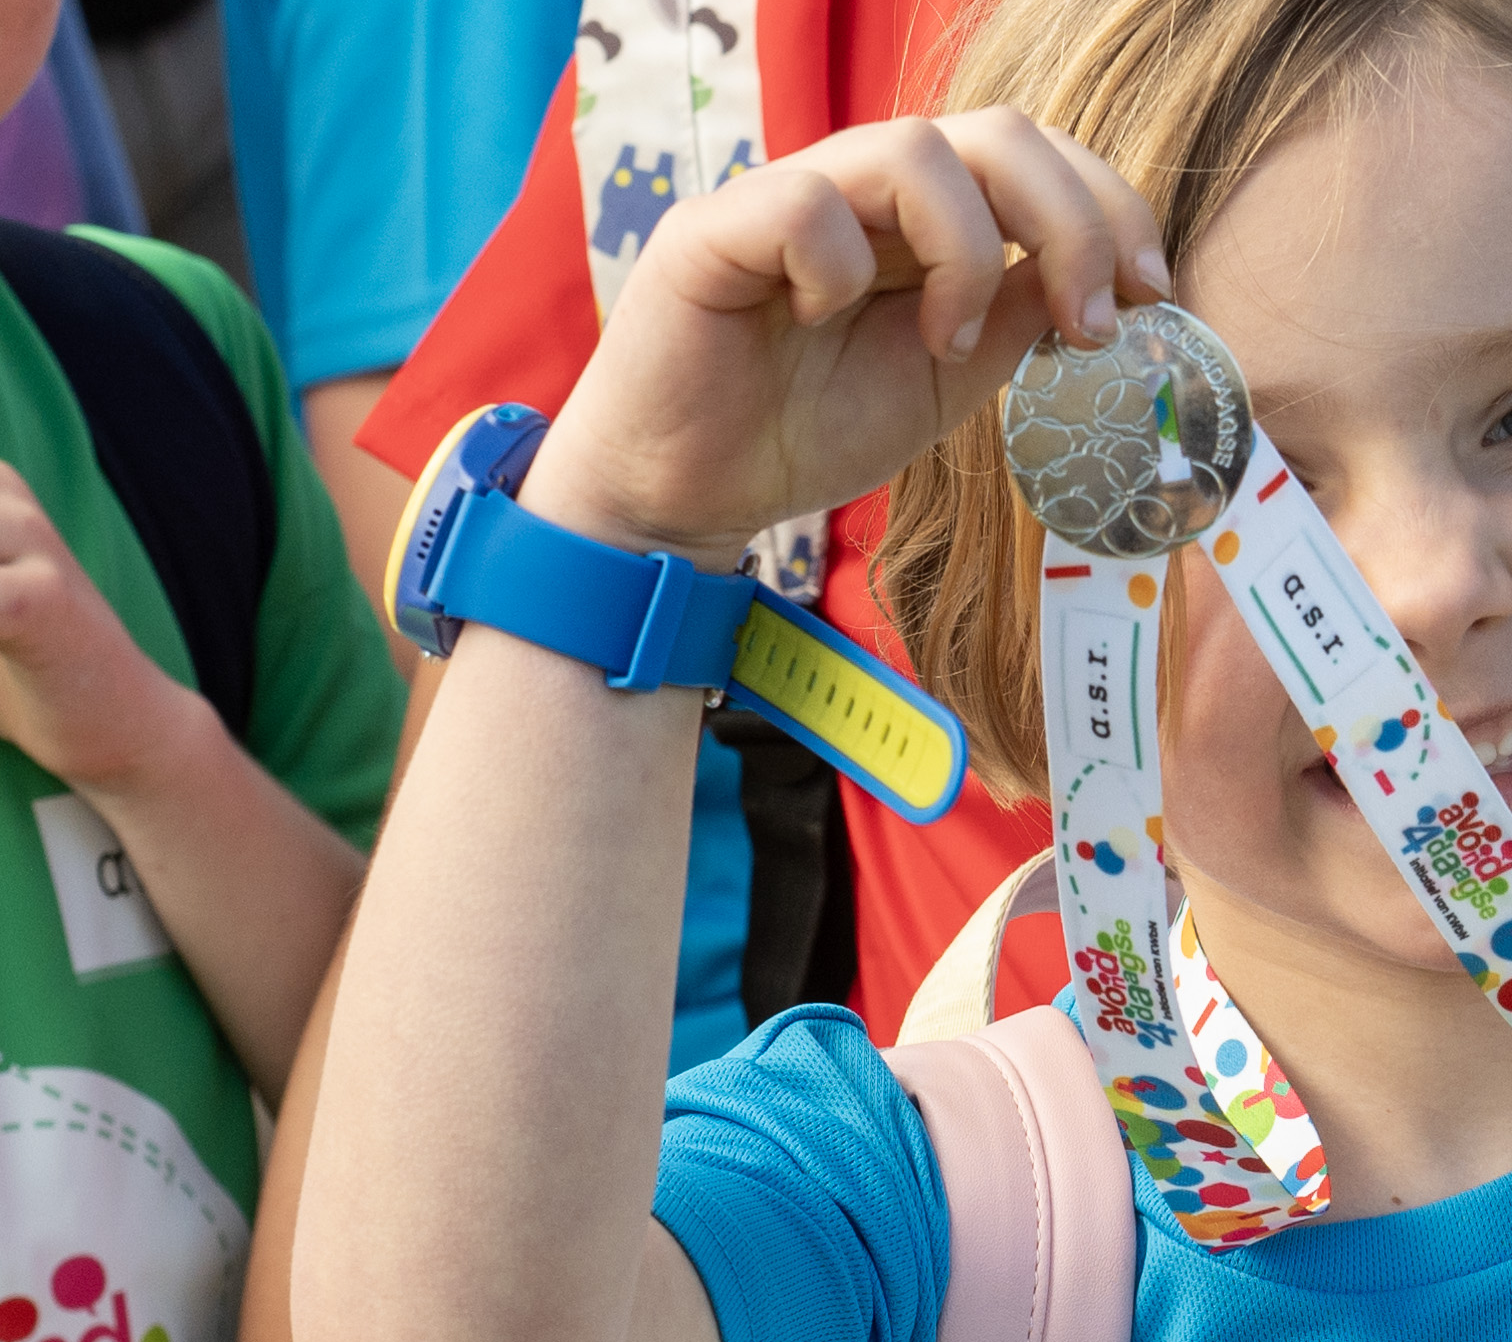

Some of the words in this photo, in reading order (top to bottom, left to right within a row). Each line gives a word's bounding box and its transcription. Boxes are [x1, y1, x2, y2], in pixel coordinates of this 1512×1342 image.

[1401, 825, 1499, 921] 4daagse
[1085, 945, 1138, 1037] avond
[1112, 917, 1179, 1048] 4daagse
